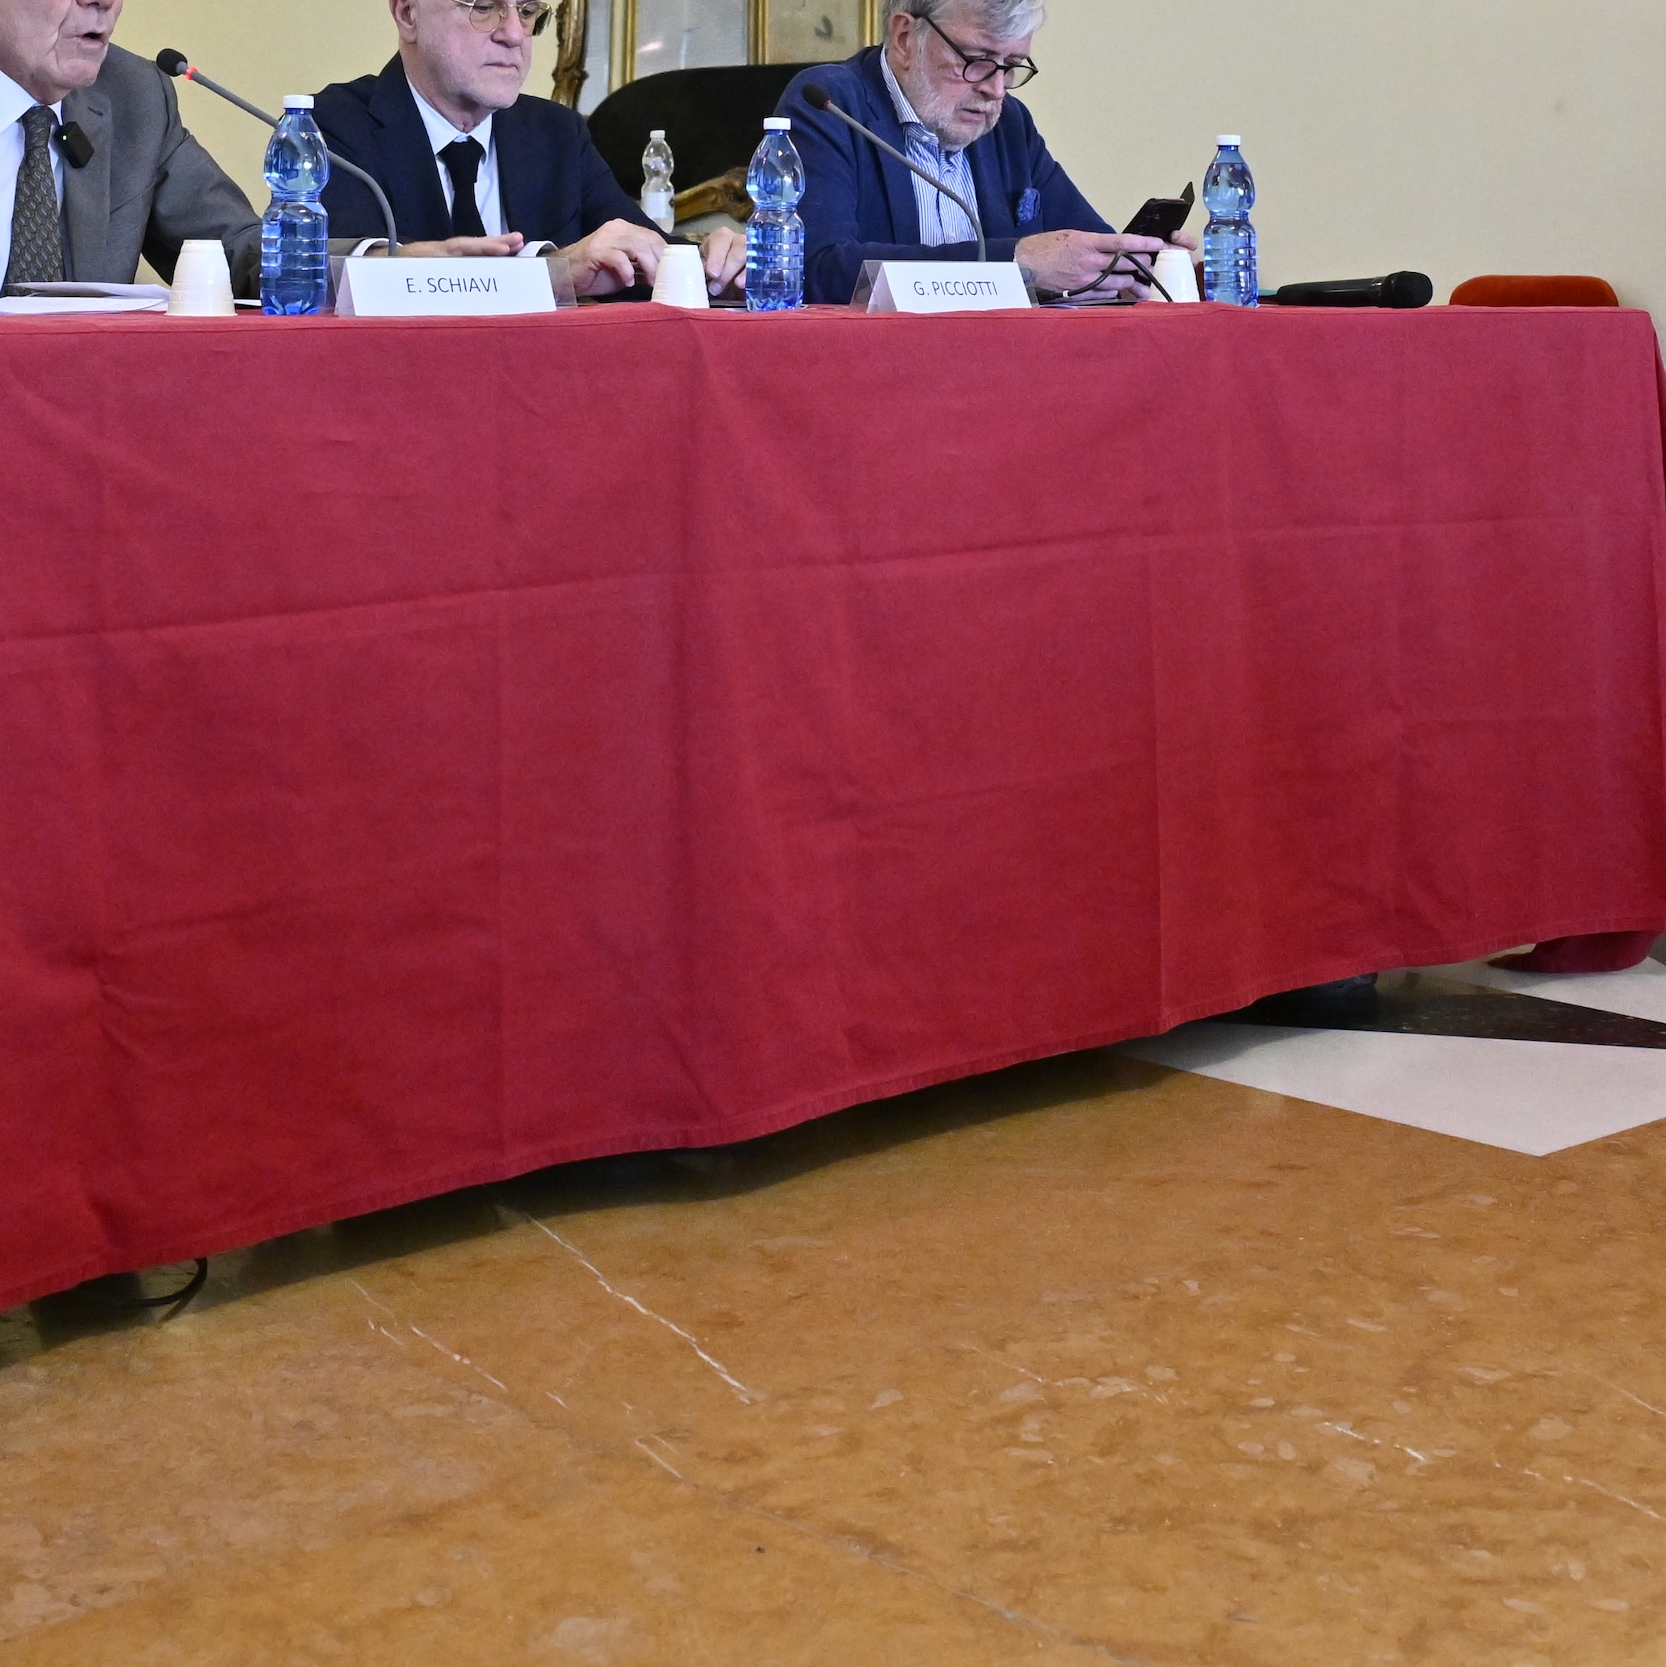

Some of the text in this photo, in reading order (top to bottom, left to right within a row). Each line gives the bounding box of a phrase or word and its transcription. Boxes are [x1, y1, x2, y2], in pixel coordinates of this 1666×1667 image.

[406, 277, 498, 293] E. SCHIAVI
[913, 281, 998, 296] G. PICCIOTTI
